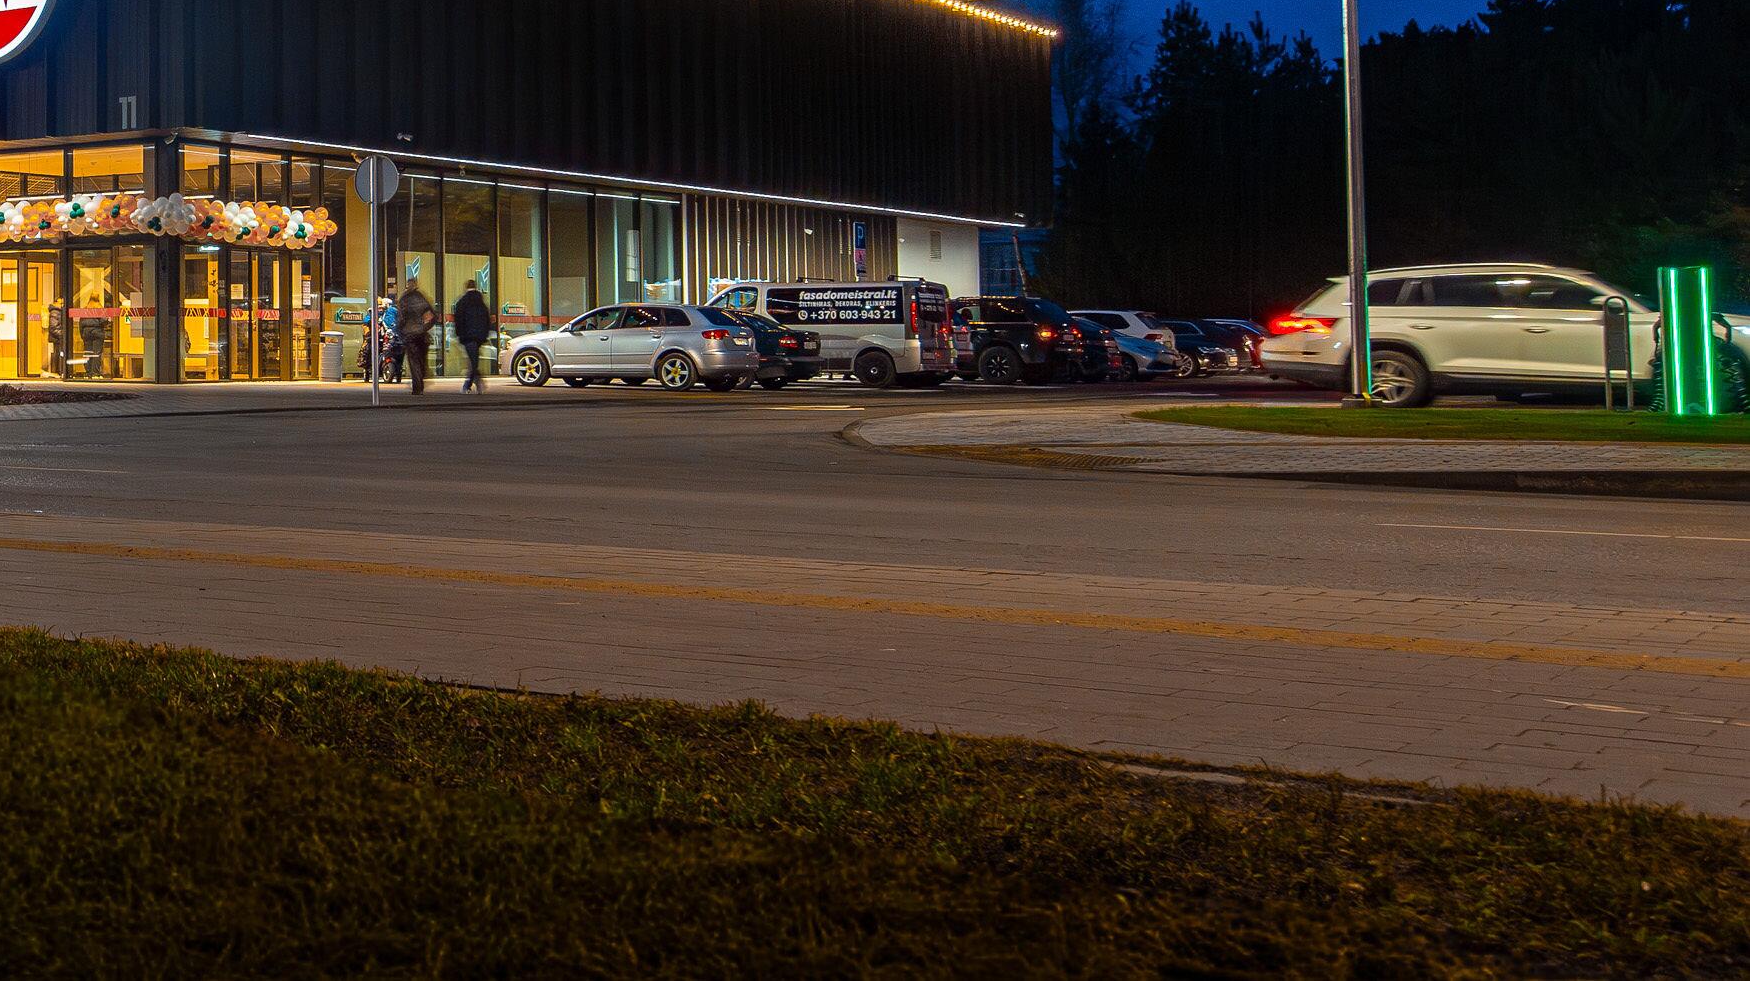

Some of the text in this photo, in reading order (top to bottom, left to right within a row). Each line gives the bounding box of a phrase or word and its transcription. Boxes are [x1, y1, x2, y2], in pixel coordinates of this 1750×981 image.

[118, 95, 137, 130] 11
[798, 289, 898, 300] fasadomeistrai.lt
[810, 310, 897, 320] +370 603-943 21
